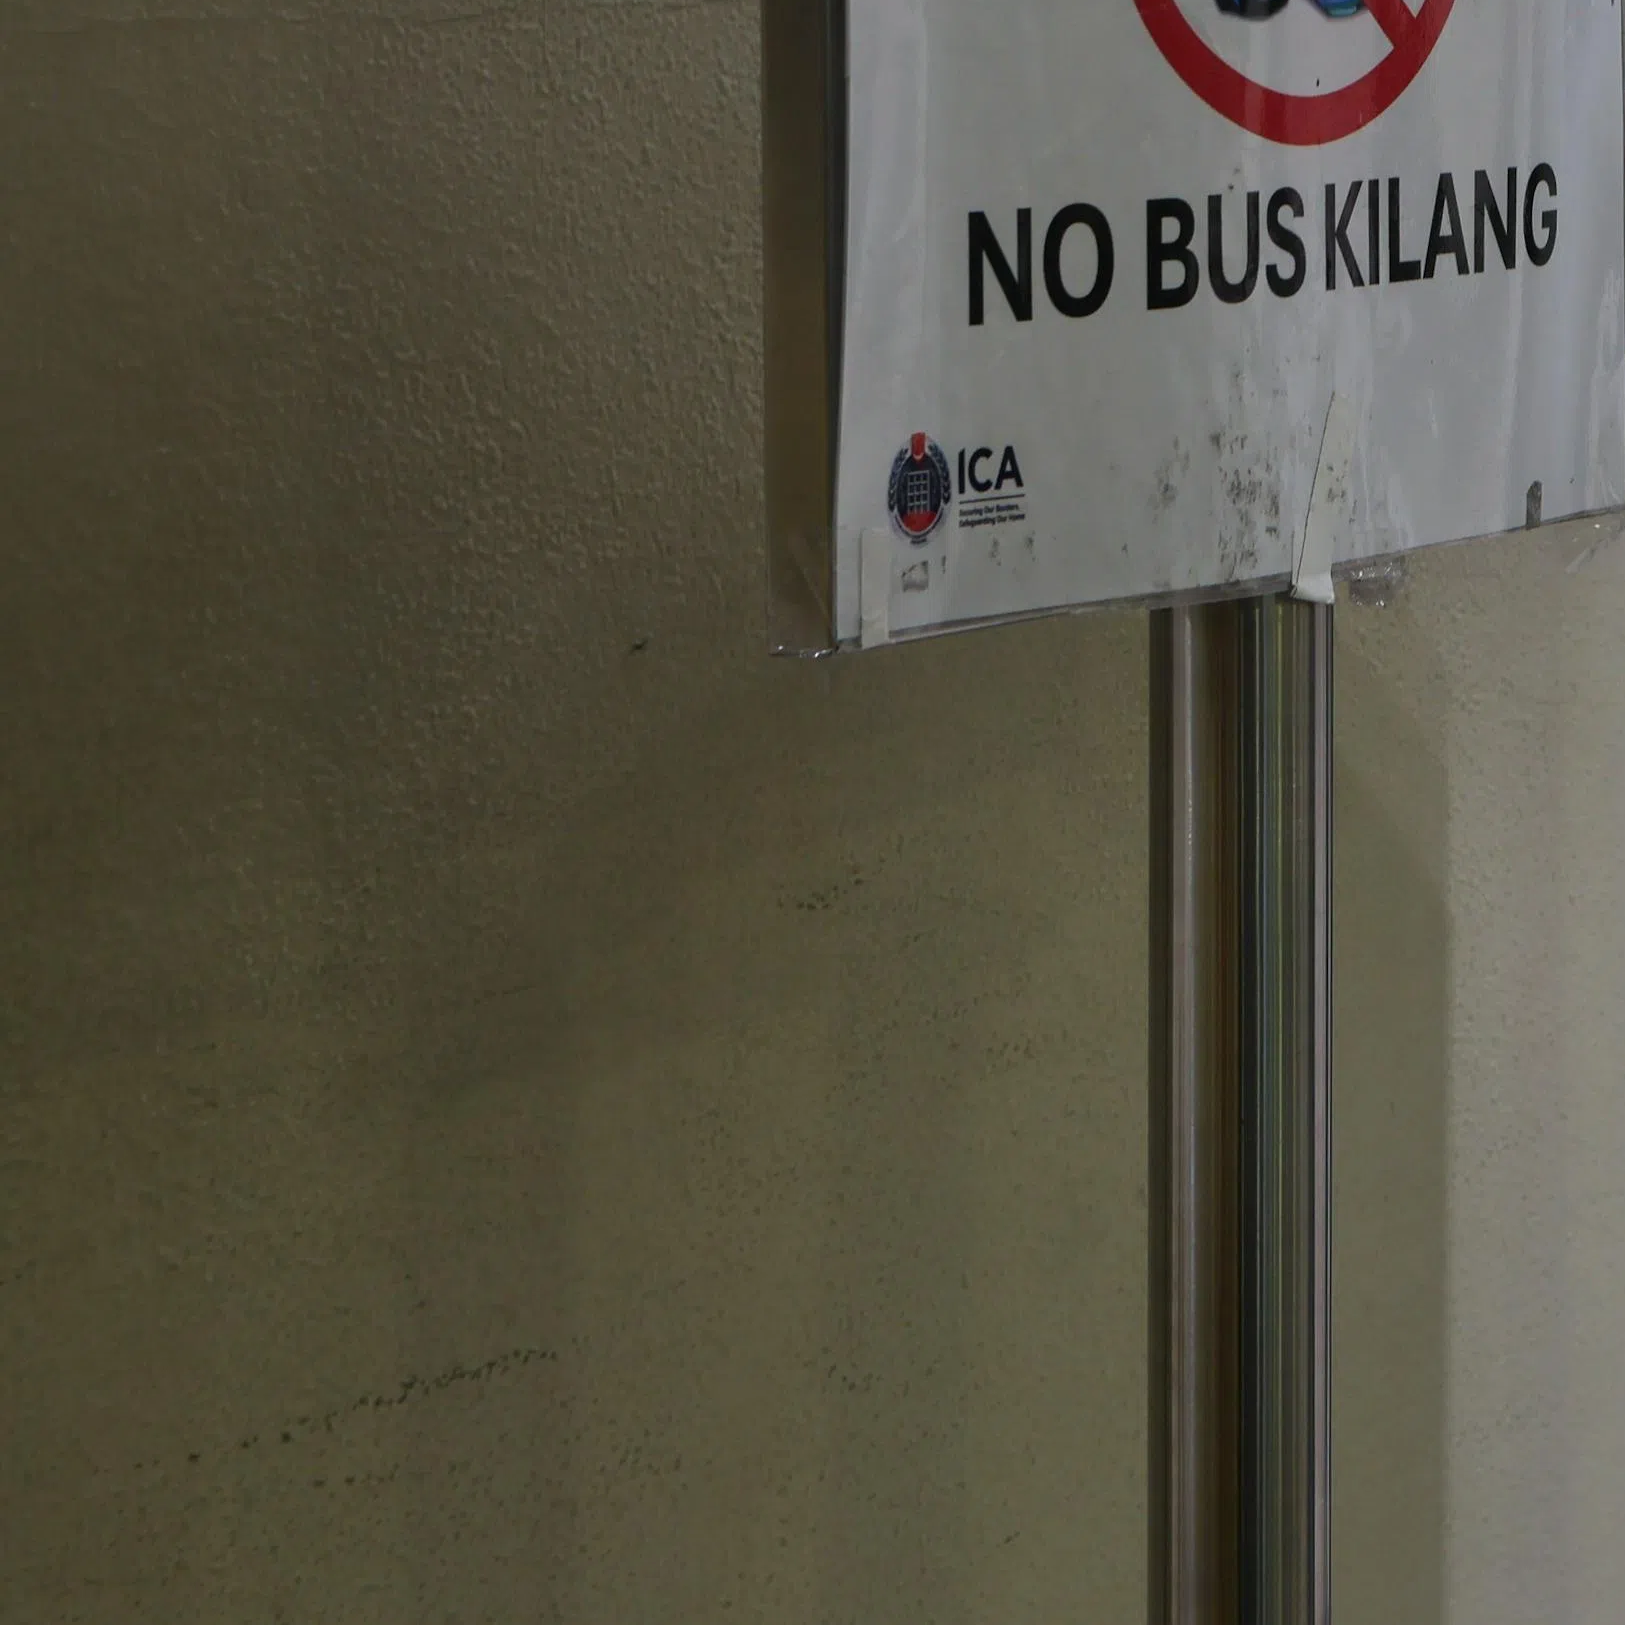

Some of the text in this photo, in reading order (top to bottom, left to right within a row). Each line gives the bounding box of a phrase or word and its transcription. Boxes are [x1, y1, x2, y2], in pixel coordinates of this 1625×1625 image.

[967, 162, 1559, 327] NO BUS KILANG
[957, 445, 1024, 495] ICA
